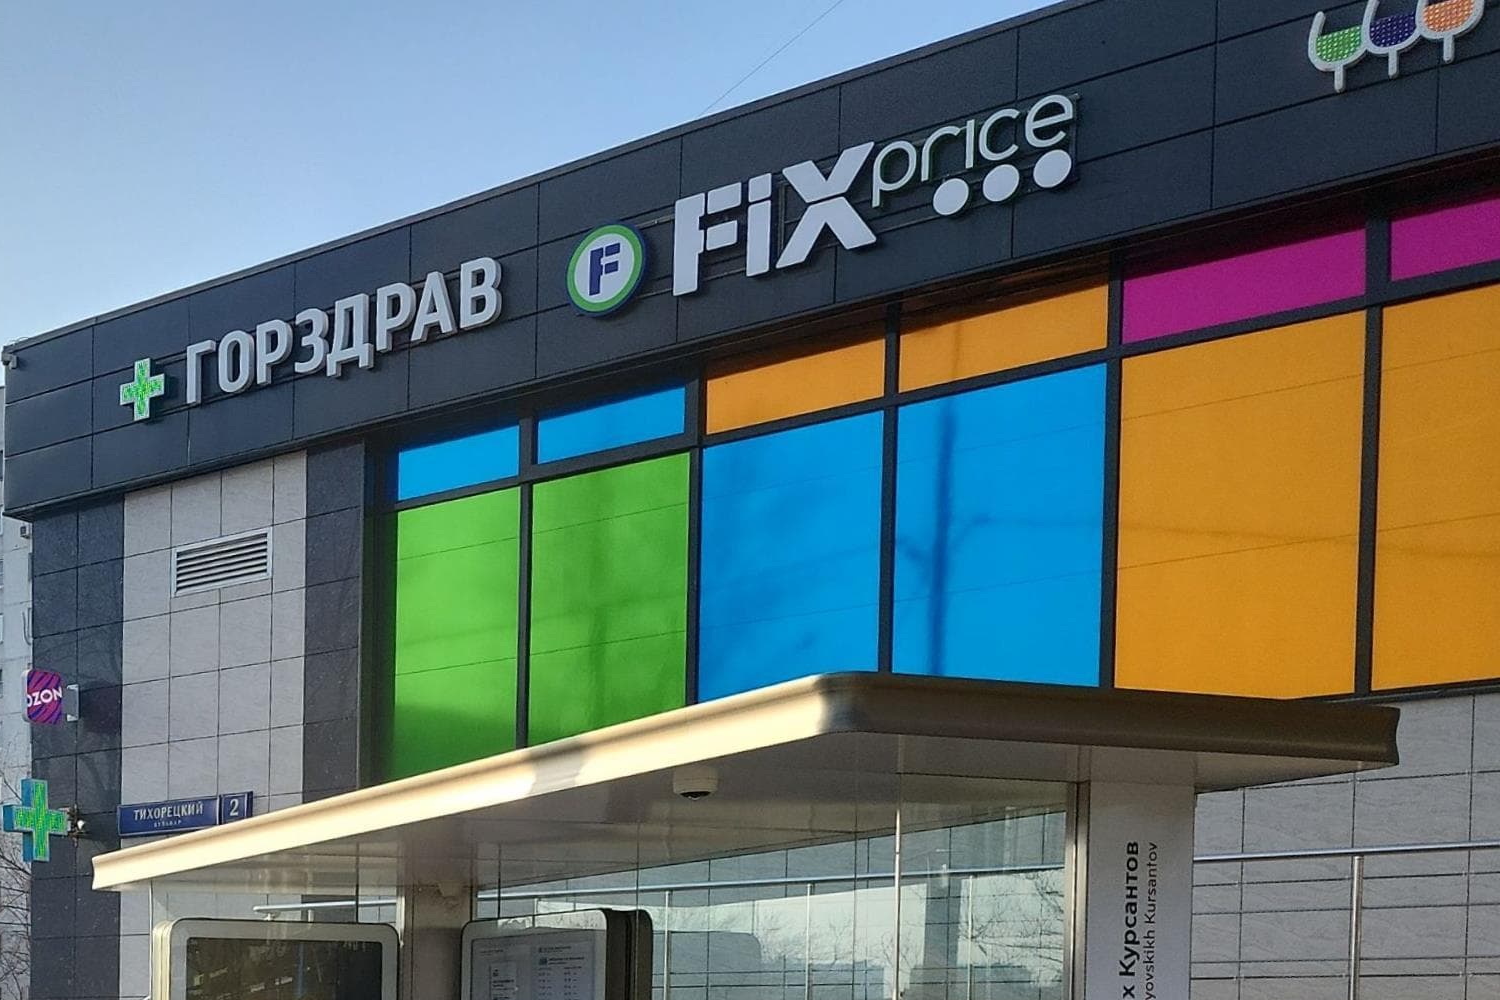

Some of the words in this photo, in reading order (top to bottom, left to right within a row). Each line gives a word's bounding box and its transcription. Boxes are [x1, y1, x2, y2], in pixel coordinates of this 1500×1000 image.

[871, 94, 1075, 208] price
[186, 256, 502, 404] ГОРЗДРАВ
[133, 801, 205, 821] ТИХОРЕЦКИЙ
[229, 798, 240, 817] 2
[1119, 841, 1140, 976] Курсантов
[1144, 842, 1159, 924] Kursantov
